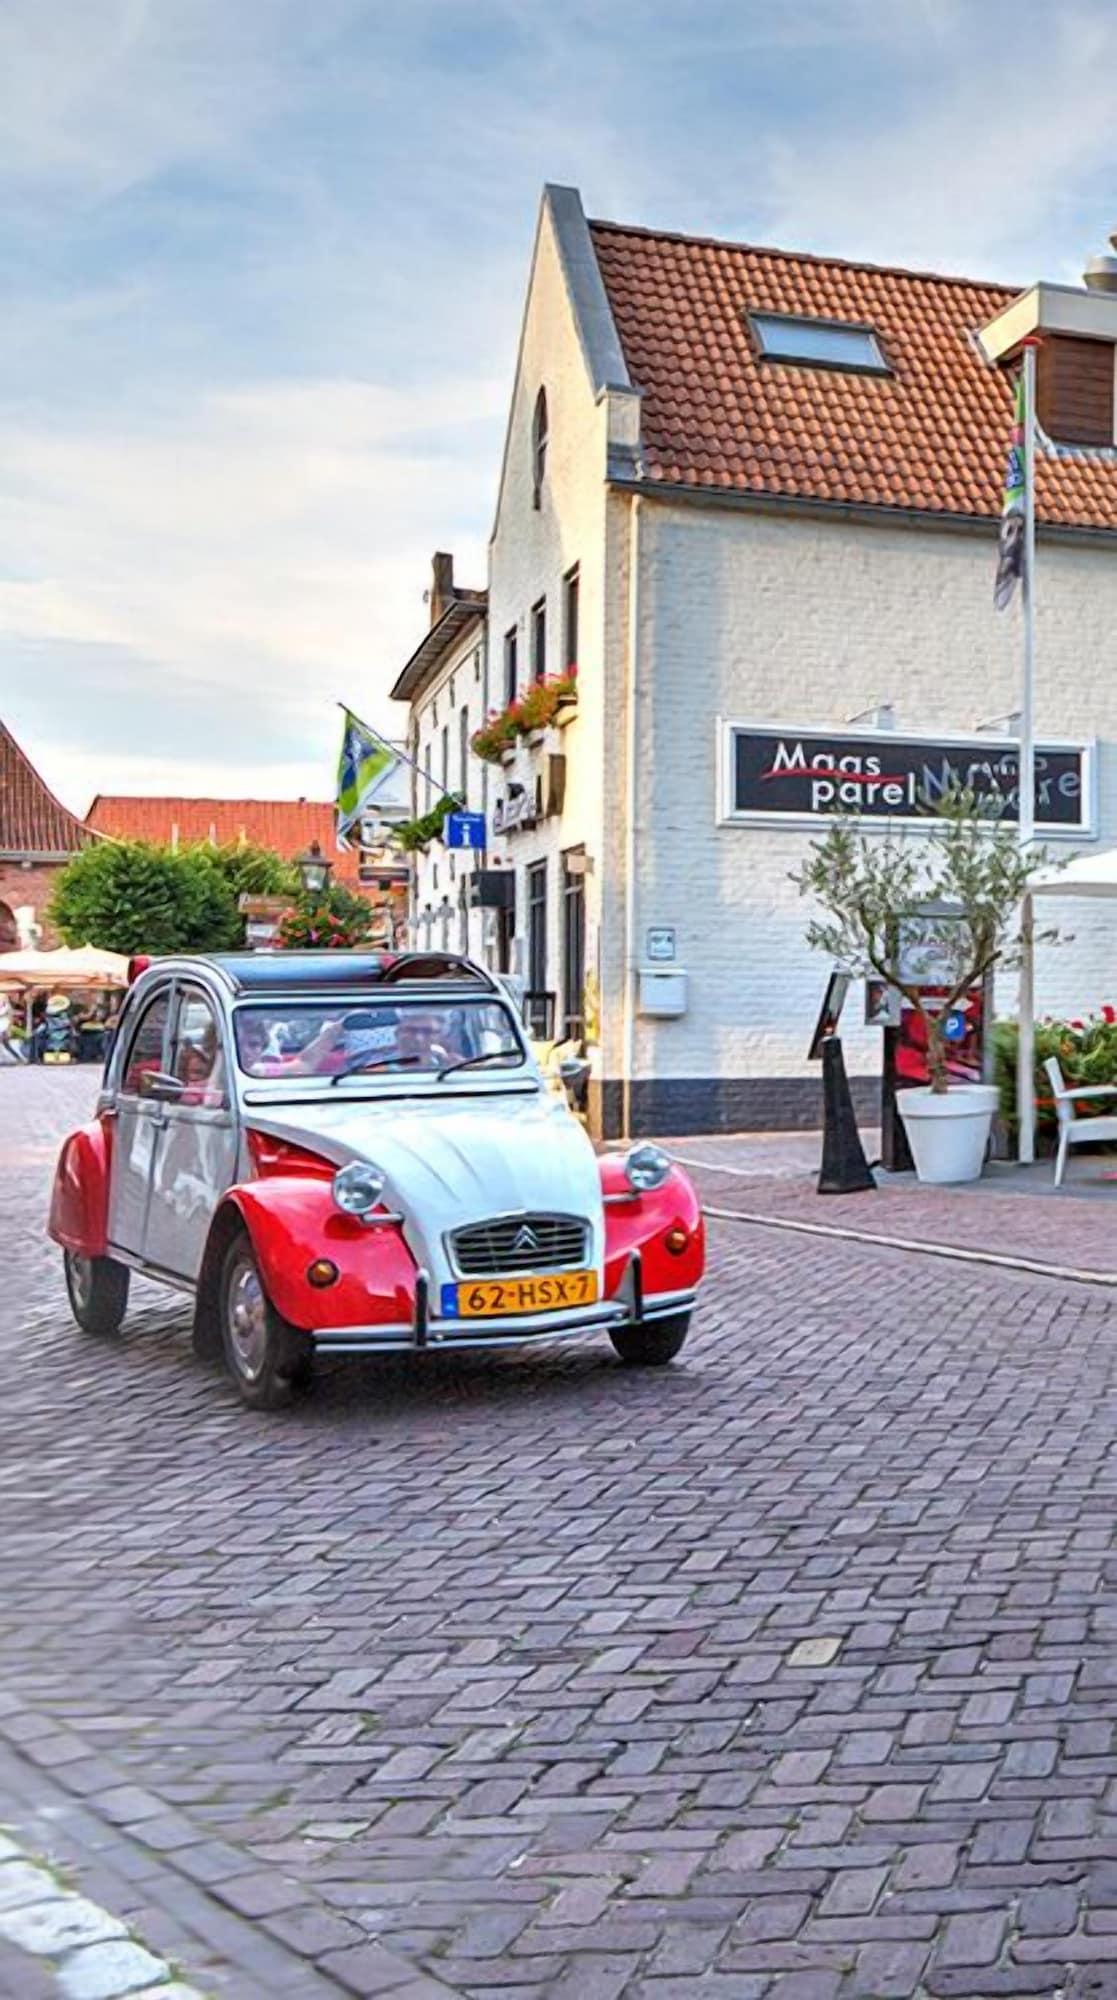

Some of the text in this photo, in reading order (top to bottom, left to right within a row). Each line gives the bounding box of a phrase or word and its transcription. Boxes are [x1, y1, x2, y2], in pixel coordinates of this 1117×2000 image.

[772, 741, 881, 776] Maas
[811, 772, 916, 811] parel
[467, 1275, 589, 1311] 62-HSX-7
